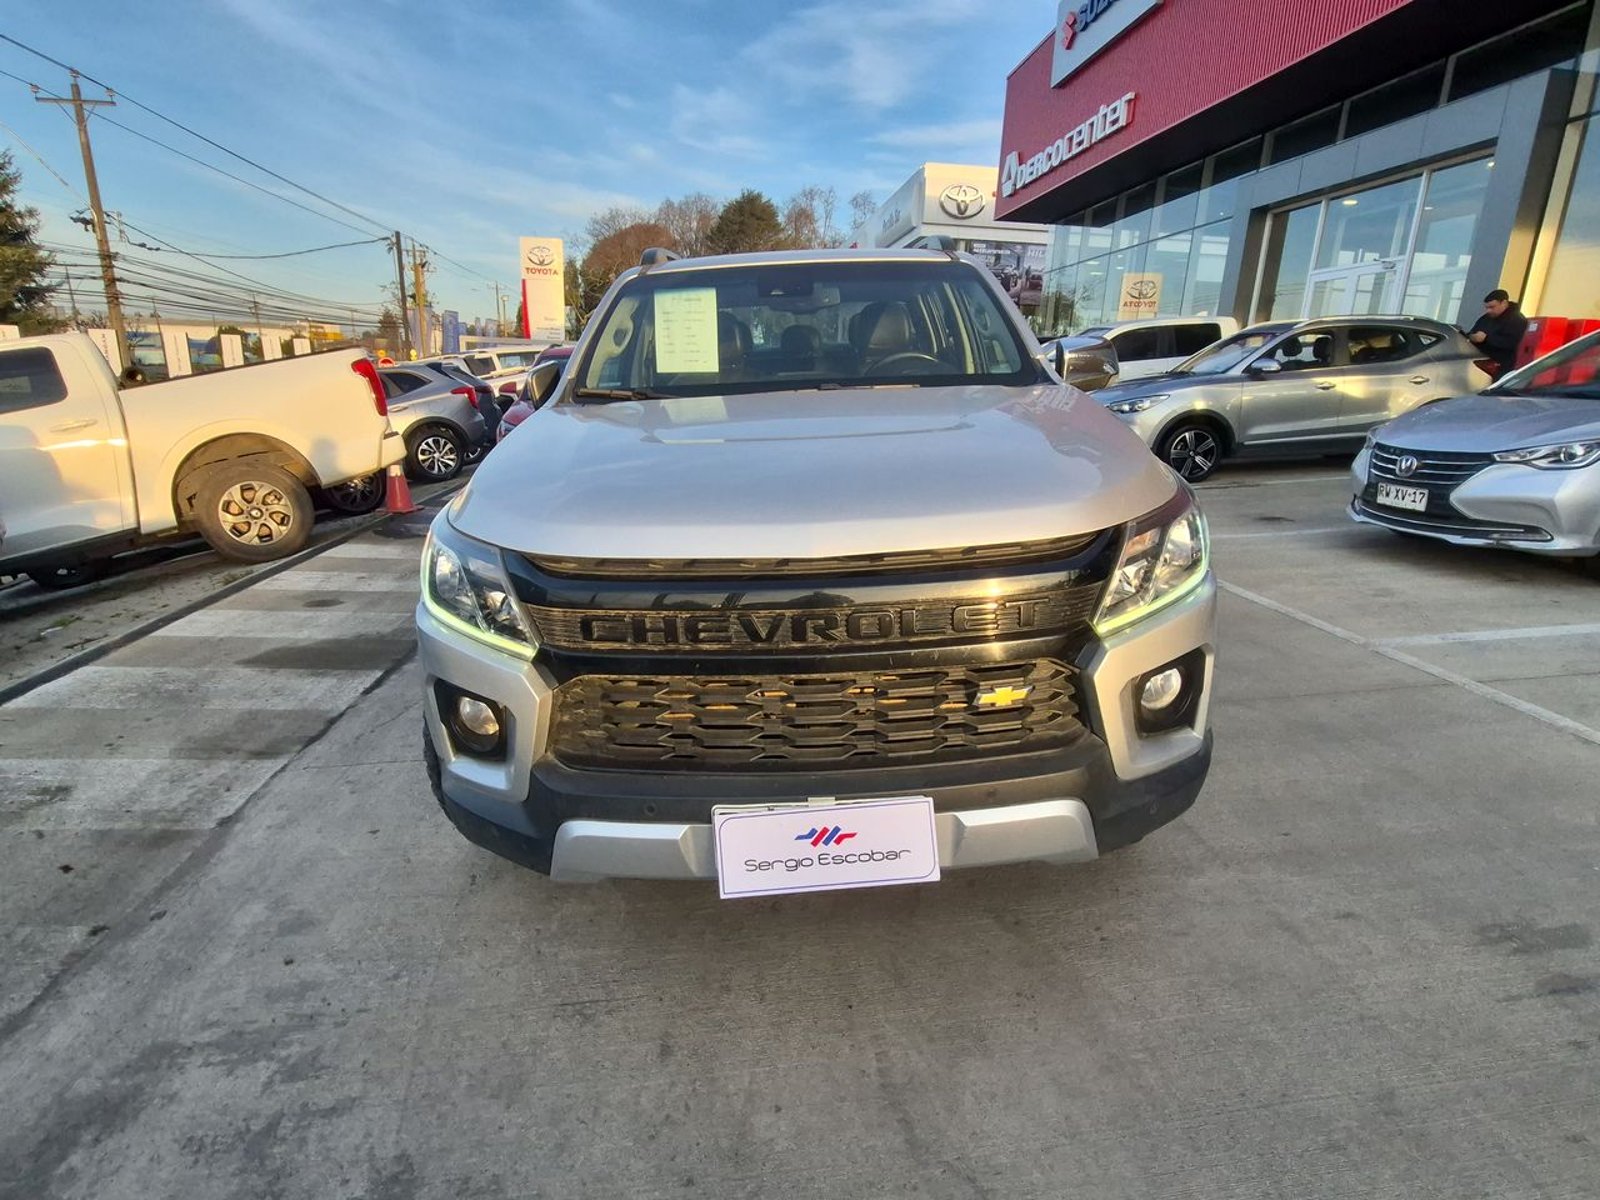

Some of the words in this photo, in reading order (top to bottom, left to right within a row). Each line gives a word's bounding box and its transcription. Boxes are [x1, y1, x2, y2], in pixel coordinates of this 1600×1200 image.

[525, 267, 559, 276] TOYOTA
[580, 598, 1050, 643] CHEVROLET
[744, 857, 814, 872] Sergio
[818, 849, 912, 866] Escobar
